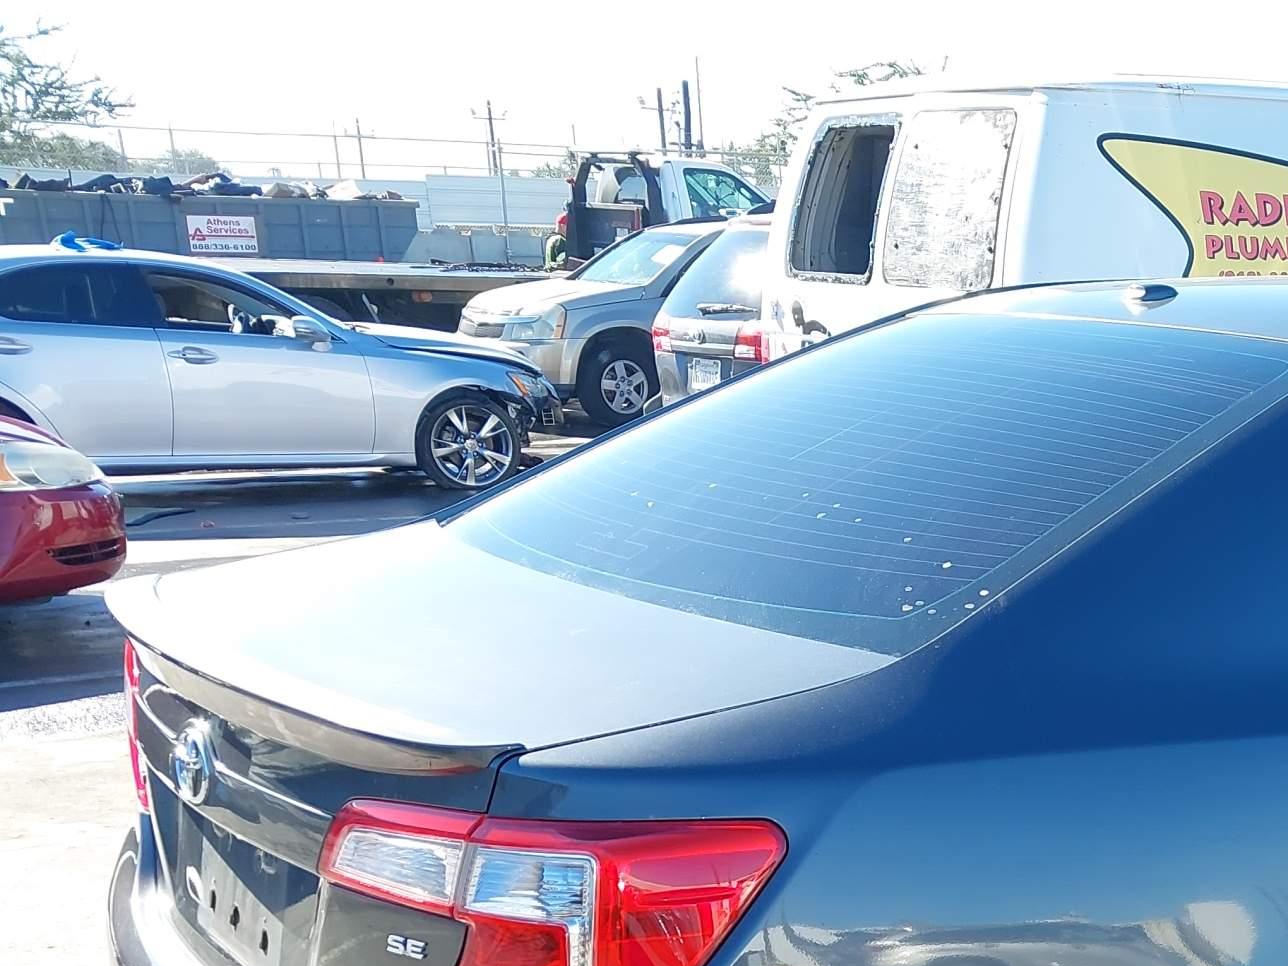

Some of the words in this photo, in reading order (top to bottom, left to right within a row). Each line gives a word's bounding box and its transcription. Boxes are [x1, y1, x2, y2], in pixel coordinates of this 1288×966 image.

[206, 217, 241, 226] Athens
[207, 226, 250, 234] Services
[386, 933, 428, 960] SE
